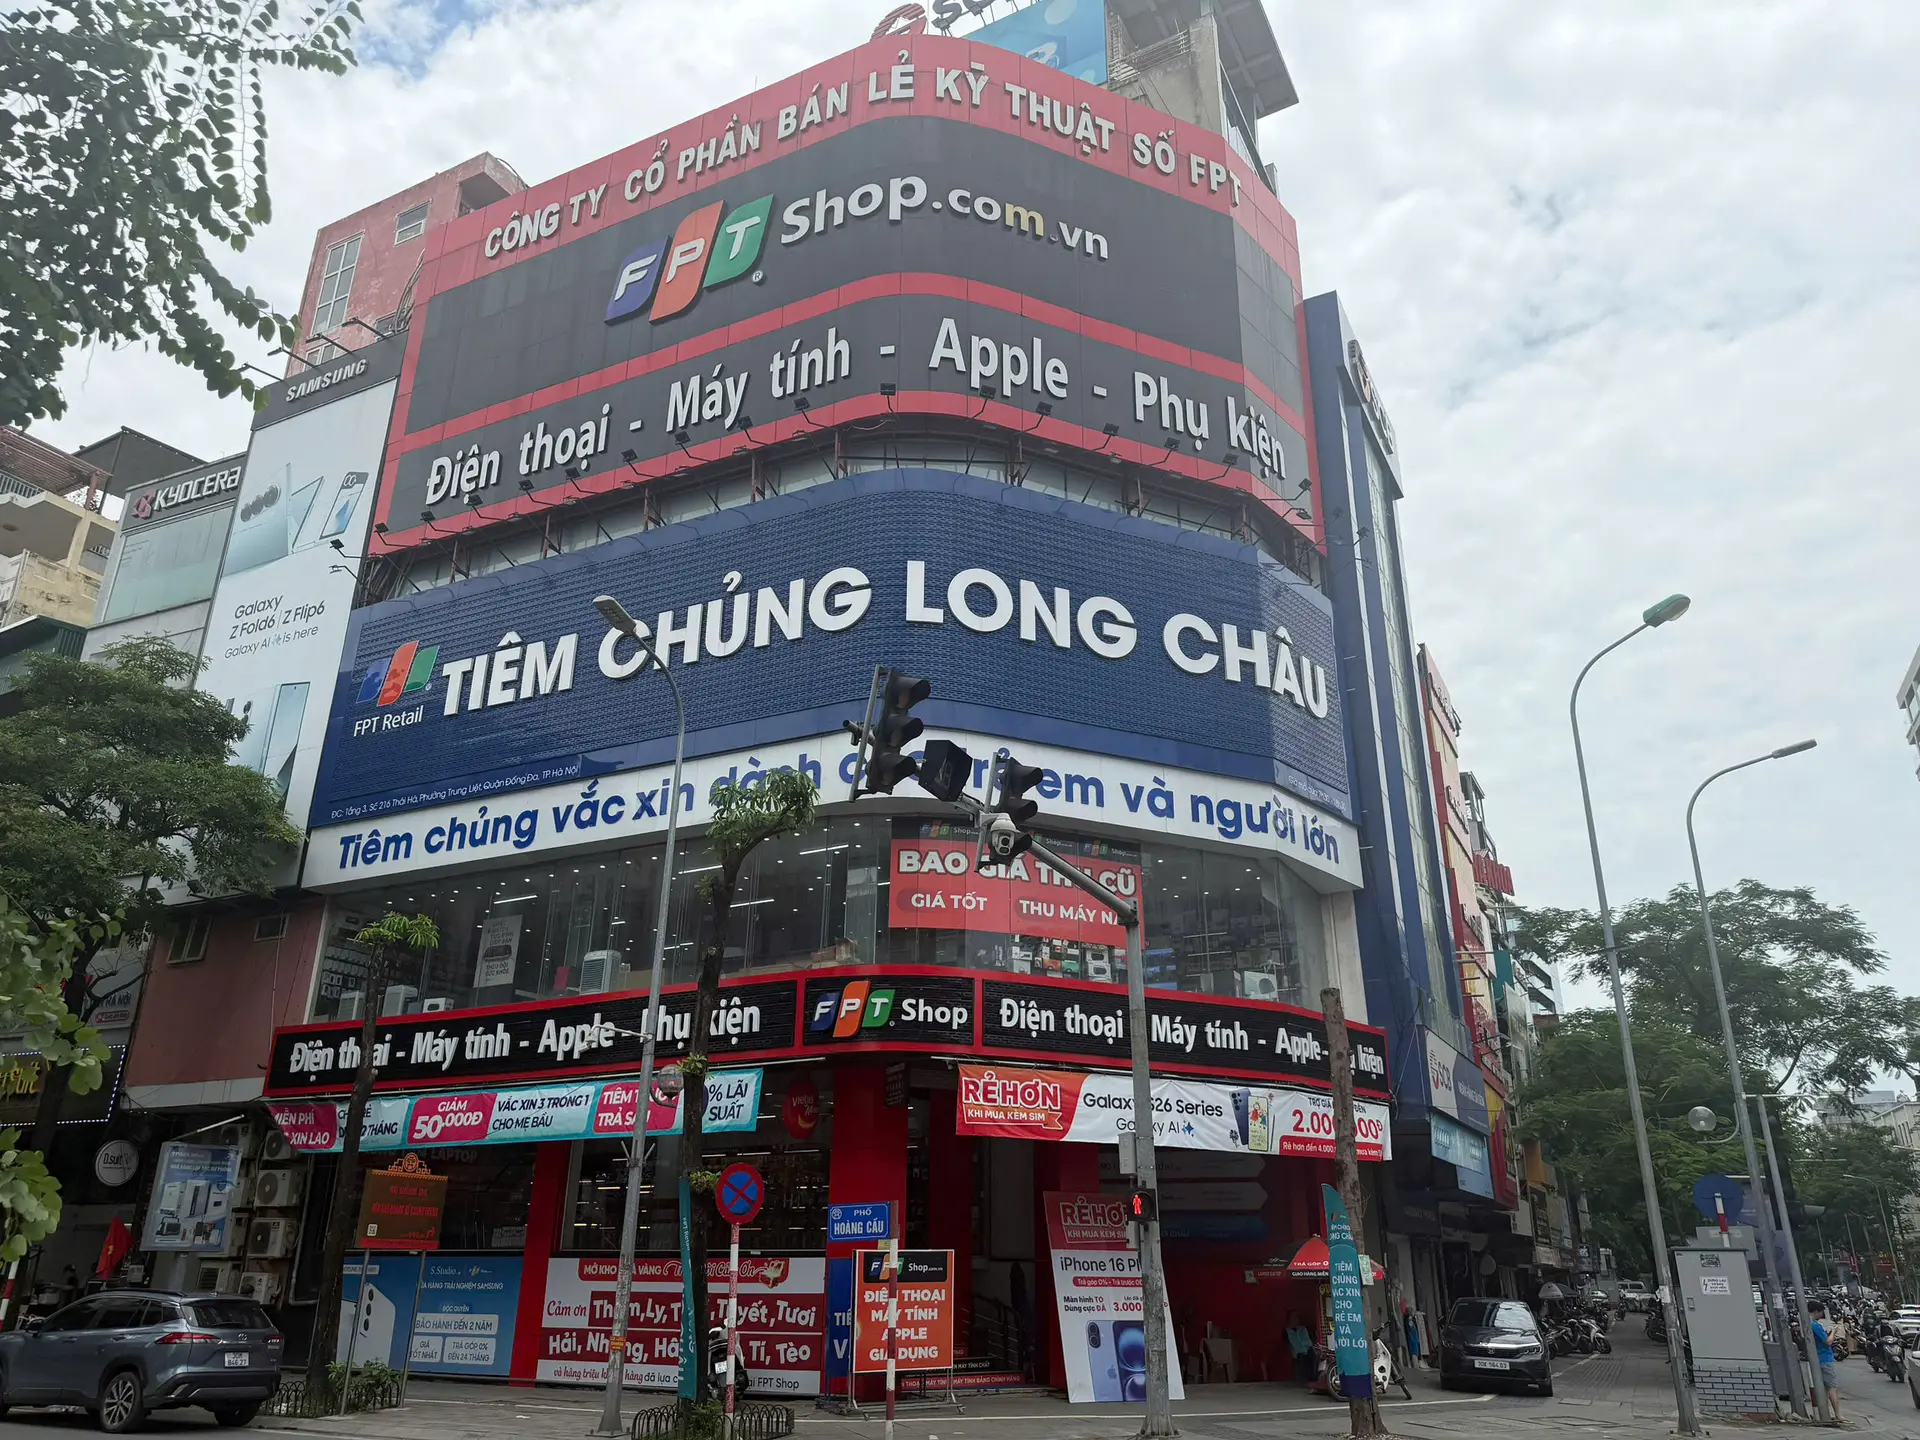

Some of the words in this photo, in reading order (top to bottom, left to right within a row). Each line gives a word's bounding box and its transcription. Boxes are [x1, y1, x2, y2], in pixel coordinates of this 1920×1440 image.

[485, 203, 560, 259] CÔNG
[569, 182, 607, 225] TY
[624, 139, 669, 202] CỔ
[677, 113, 762, 182] PHẦN
[777, 84, 849, 140] BÁN
[868, 49, 915, 104] LẺ
[936, 62, 990, 107] KỸ
[1005, 83, 1115, 154] THUẬT
[1133, 129, 1177, 175] SỐ
[1190, 153, 1241, 207] FPT
[610, 208, 765, 306] FPT
[781, 175, 1109, 261] Shop.com.vn
[286, 359, 367, 402] SAMSUNG
[425, 445, 501, 506] Điện
[520, 403, 611, 471] thoại
[666, 363, 749, 430] Máy
[770, 327, 851, 399] tính
[928, 317, 1069, 398] Apple
[1134, 371, 1209, 451] Phụ
[1227, 396, 1286, 480] kiện
[152, 466, 243, 512] KYOCERA
[235, 595, 284, 619] Galaxy
[230, 624, 240, 640] Z
[240, 614, 276, 637] Fold6
[282, 609, 293, 625] Z
[293, 600, 325, 624] Flip6
[224, 642, 260, 660] Galaxy
[260, 637, 271, 650] AI
[282, 632, 291, 644] is
[293, 625, 319, 641] here
[442, 631, 579, 716] TIÊM
[598, 567, 872, 680] CHỦNG
[905, 560, 1138, 659] LONG
[1163, 612, 1328, 719] CHÂU
[353, 716, 380, 737] FPT
[382, 704, 424, 731] Retail
[448, 786, 468, 797] Trung
[483, 779, 505, 791] Quận
[552, 768, 563, 778] Hà
[564, 765, 579, 776] Nội
[339, 828, 414, 870] Tiêm
[424, 805, 539, 855] chủng
[552, 779, 626, 832] vắc
[632, 778, 695, 821] xin
[1035, 768, 1105, 808] em
[1120, 775, 1175, 819] và
[1190, 793, 1297, 840] người
[1302, 822, 1340, 864] lớn
[899, 850, 969, 874] BAO
[1098, 866, 1137, 896] CŨ
[911, 891, 946, 911] GIÁ
[950, 890, 988, 911] TỐT
[1019, 900, 1056, 920] THU
[1059, 904, 1096, 924] MÁY
[811, 990, 893, 1026] FPT
[901, 998, 968, 1030] Shop
[290, 1040, 335, 1082] Điện
[411, 1029, 459, 1071] Máy
[465, 1023, 511, 1060] tính
[538, 1012, 615, 1061] Apple
[1000, 998, 1055, 1038] Điện
[1064, 1004, 1124, 1045] thoại
[1152, 1014, 1197, 1053] Máy
[1205, 1020, 1249, 1051] tính
[1357, 1044, 1384, 1080] kiện
[1437, 1062, 1452, 1092] SCB
[603, 1087, 632, 1105] TIÊM
[726, 1079, 749, 1099] LÃI
[438, 1097, 468, 1113] GIẢM
[498, 1095, 519, 1112] VẮC
[519, 1098, 537, 1111] XIN
[537, 1098, 546, 1110] 3
[546, 1095, 583, 1109] TRONG
[709, 1102, 744, 1121] SUẤT
[1176, 1099, 1223, 1117] Series
[298, 1108, 315, 1125] PHÍ
[492, 1117, 514, 1131] CHO
[514, 1116, 530, 1132] MẸ
[530, 1111, 554, 1128] BẦU
[598, 1106, 623, 1127] TRẢ
[967, 1108, 983, 1118] KHI
[984, 1109, 1004, 1120] MUA
[1007, 1108, 1028, 1121] KÈM
[1029, 1111, 1046, 1122] SIM
[368, 1120, 399, 1137] THÁNG
[1168, 1120, 1180, 1134] AI
[290, 1131, 308, 1145] XIN
[308, 1131, 330, 1145] LAO
[1283, 1141, 1291, 1150] Rẻ
[1292, 1142, 1305, 1151] hơn
[1305, 1143, 1317, 1152] đến
[854, 1207, 872, 1216] PHỐ
[834, 1220, 864, 1235] HOÀNG
[1067, 1230, 1081, 1238] KHI
[1081, 1230, 1098, 1238] MUA
[430, 1265, 457, 1276] S.Studio
[583, 1262, 598, 1275] MỞ
[638, 1262, 662, 1275] VÀNG
[1060, 1256, 1107, 1272] iPhone
[1109, 1257, 1126, 1272] 16
[476, 1281, 504, 1290] SAMSUNG
[1346, 1287, 1361, 1298] XIN
[901, 1288, 946, 1304] THOẠI
[1063, 1295, 1078, 1303] Màn
[1078, 1295, 1094, 1303] hình
[1335, 1300, 1352, 1309] CHO
[547, 1300, 571, 1317] Cảm
[573, 1305, 587, 1317] ơn
[776, 1299, 817, 1327] Tươi
[905, 1305, 938, 1321] TÍNH
[1347, 1313, 1362, 1322] EM
[416, 1318, 432, 1329] BẢO
[432, 1318, 453, 1330] HÀNH
[453, 1318, 468, 1330] ĐẾN
[468, 1321, 474, 1331] 2
[474, 1319, 493, 1331] NĂM
[1339, 1324, 1352, 1335] VÀ
[420, 1339, 430, 1348] GIÁ
[464, 1340, 478, 1350] GÓP
[548, 1331, 582, 1355] Hải,
[749, 1340, 771, 1366] Tí,
[775, 1341, 811, 1364] Tèo
[421, 1349, 438, 1360] NHẤT
[448, 1351, 459, 1360] ĐẾN
[459, 1352, 468, 1361] 24
[468, 1351, 490, 1362] THÁNG
[898, 1346, 939, 1362] DỤNG
[563, 1365, 582, 1380] hàng
[582, 1366, 600, 1380] triệu
[624, 1368, 643, 1384] hàng
[644, 1371, 656, 1383] đã
[657, 1371, 671, 1385] lựa
[757, 1377, 774, 1387] FPT
[775, 1377, 800, 1390] Shop
